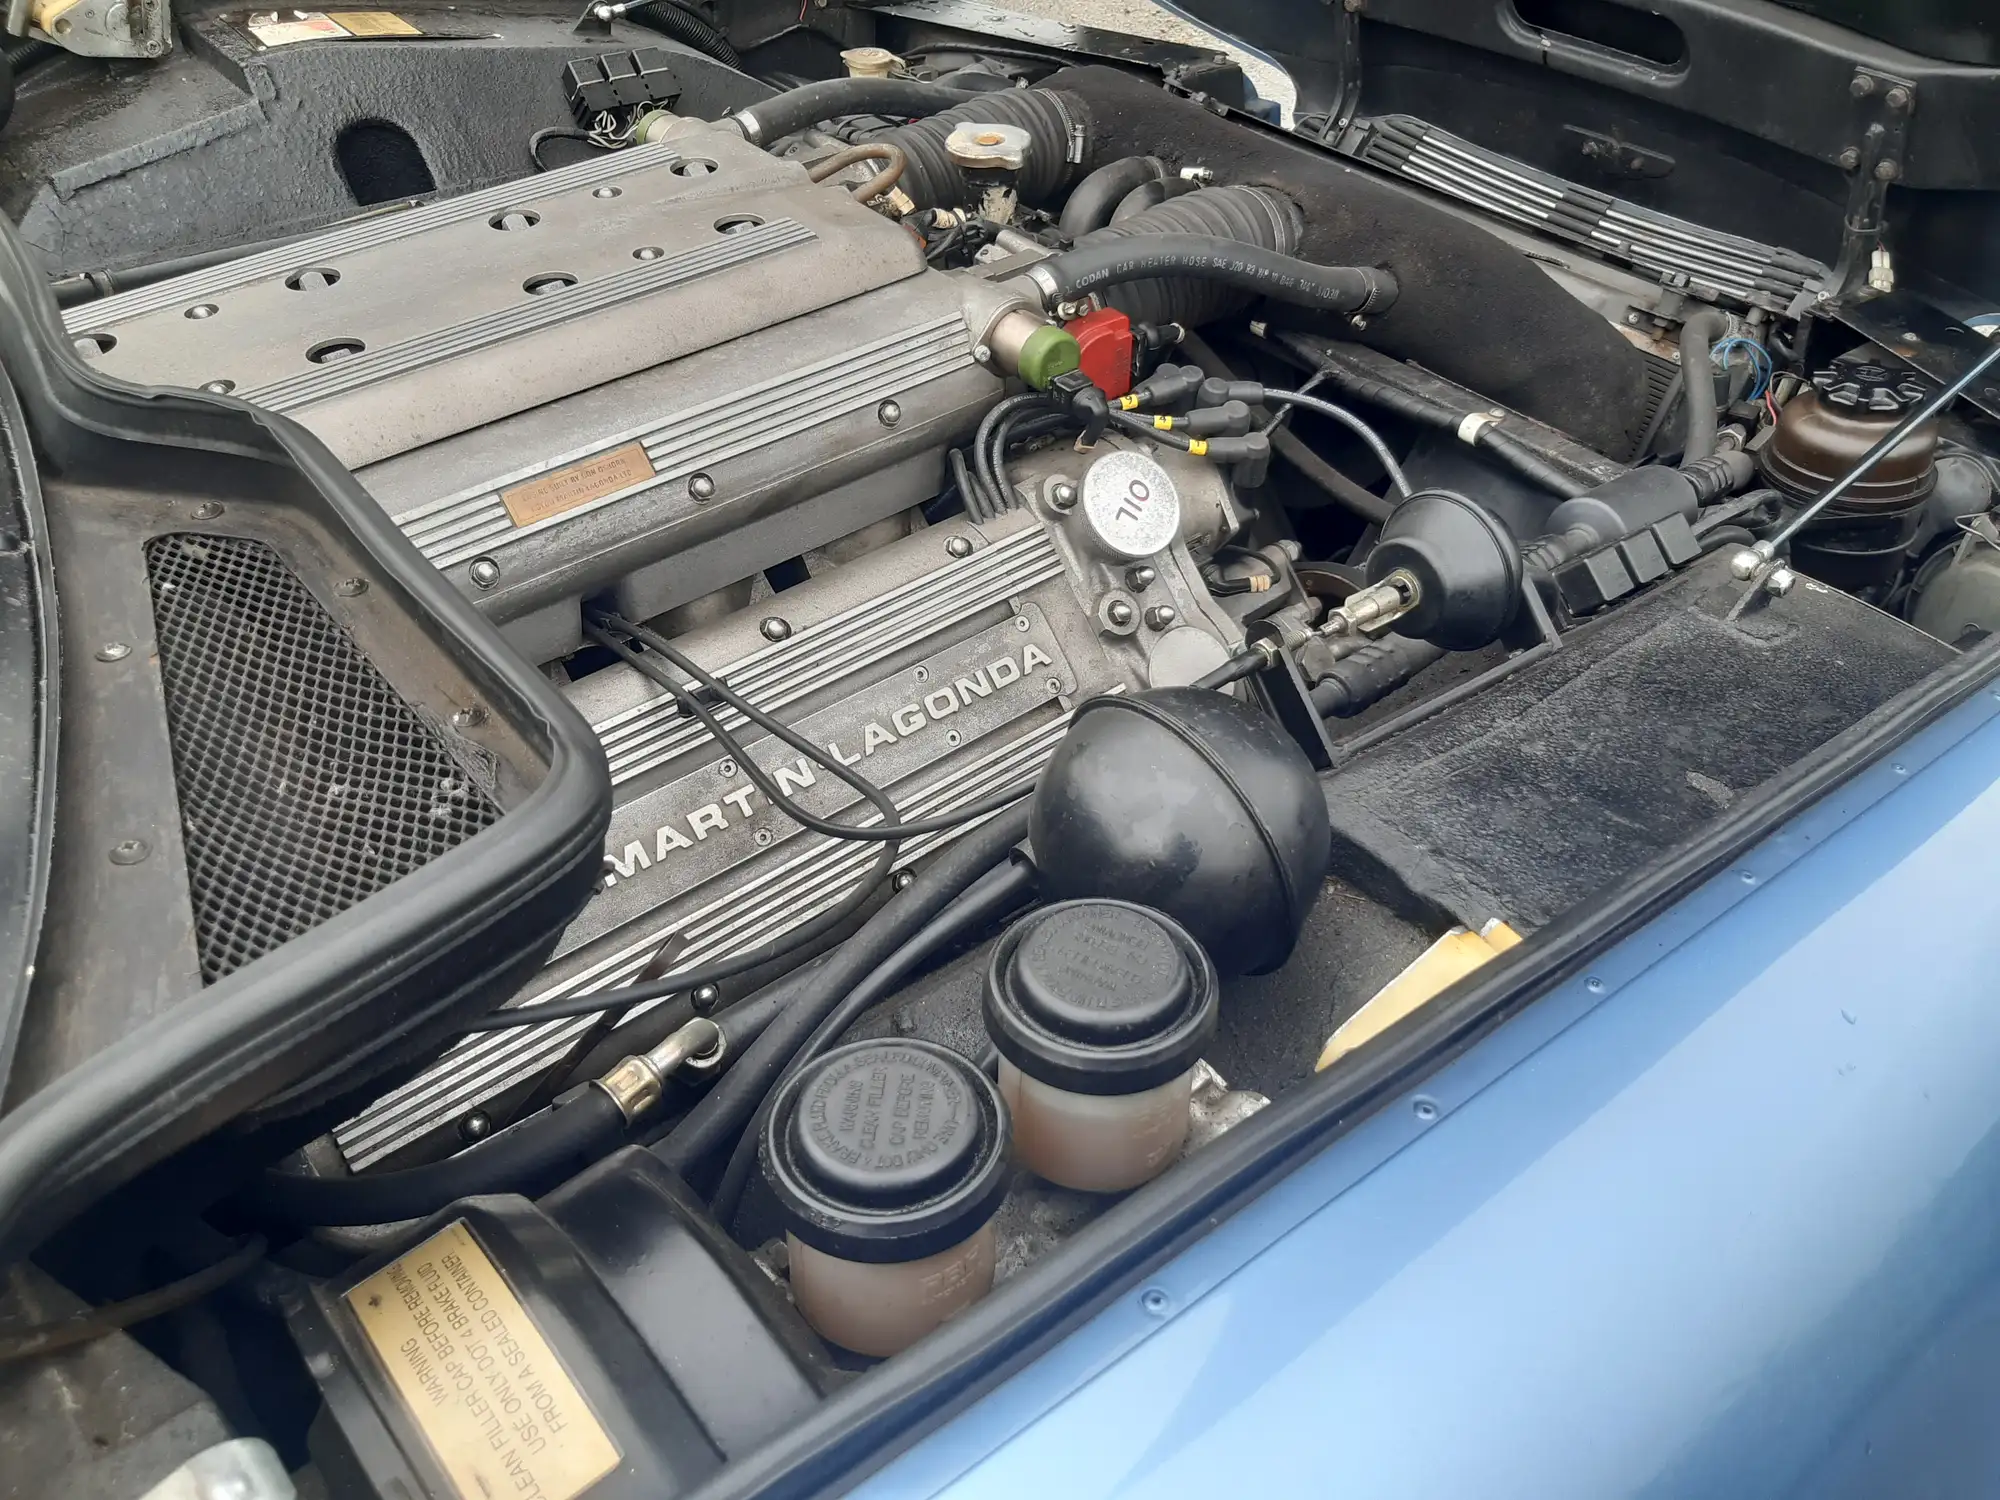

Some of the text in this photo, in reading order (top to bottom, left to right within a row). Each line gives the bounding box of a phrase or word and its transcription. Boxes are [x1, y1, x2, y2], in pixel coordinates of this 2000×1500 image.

[1076, 268, 1109, 290] CODAN
[1116, 261, 1135, 274] CAR
[1182, 256, 1207, 268] HOSE
[1212, 257, 1228, 269] SAE
[1116, 480, 1150, 520] OIL
[604, 643, 1054, 888] MARTN LAGONDA
[413, 1306, 455, 1360] BEFORE
[417, 1262, 547, 1455] USE ONLY DOT 4 BRAKE FLUID
[481, 1309, 526, 1367] SEALED
[401, 1338, 449, 1407] WARNING
[446, 1360, 474, 1391] CAP
[518, 1366, 535, 1380] A
[465, 1389, 510, 1451] FILLER
[526, 1380, 568, 1434] FROM
[501, 1448, 547, 1500] LEAN
